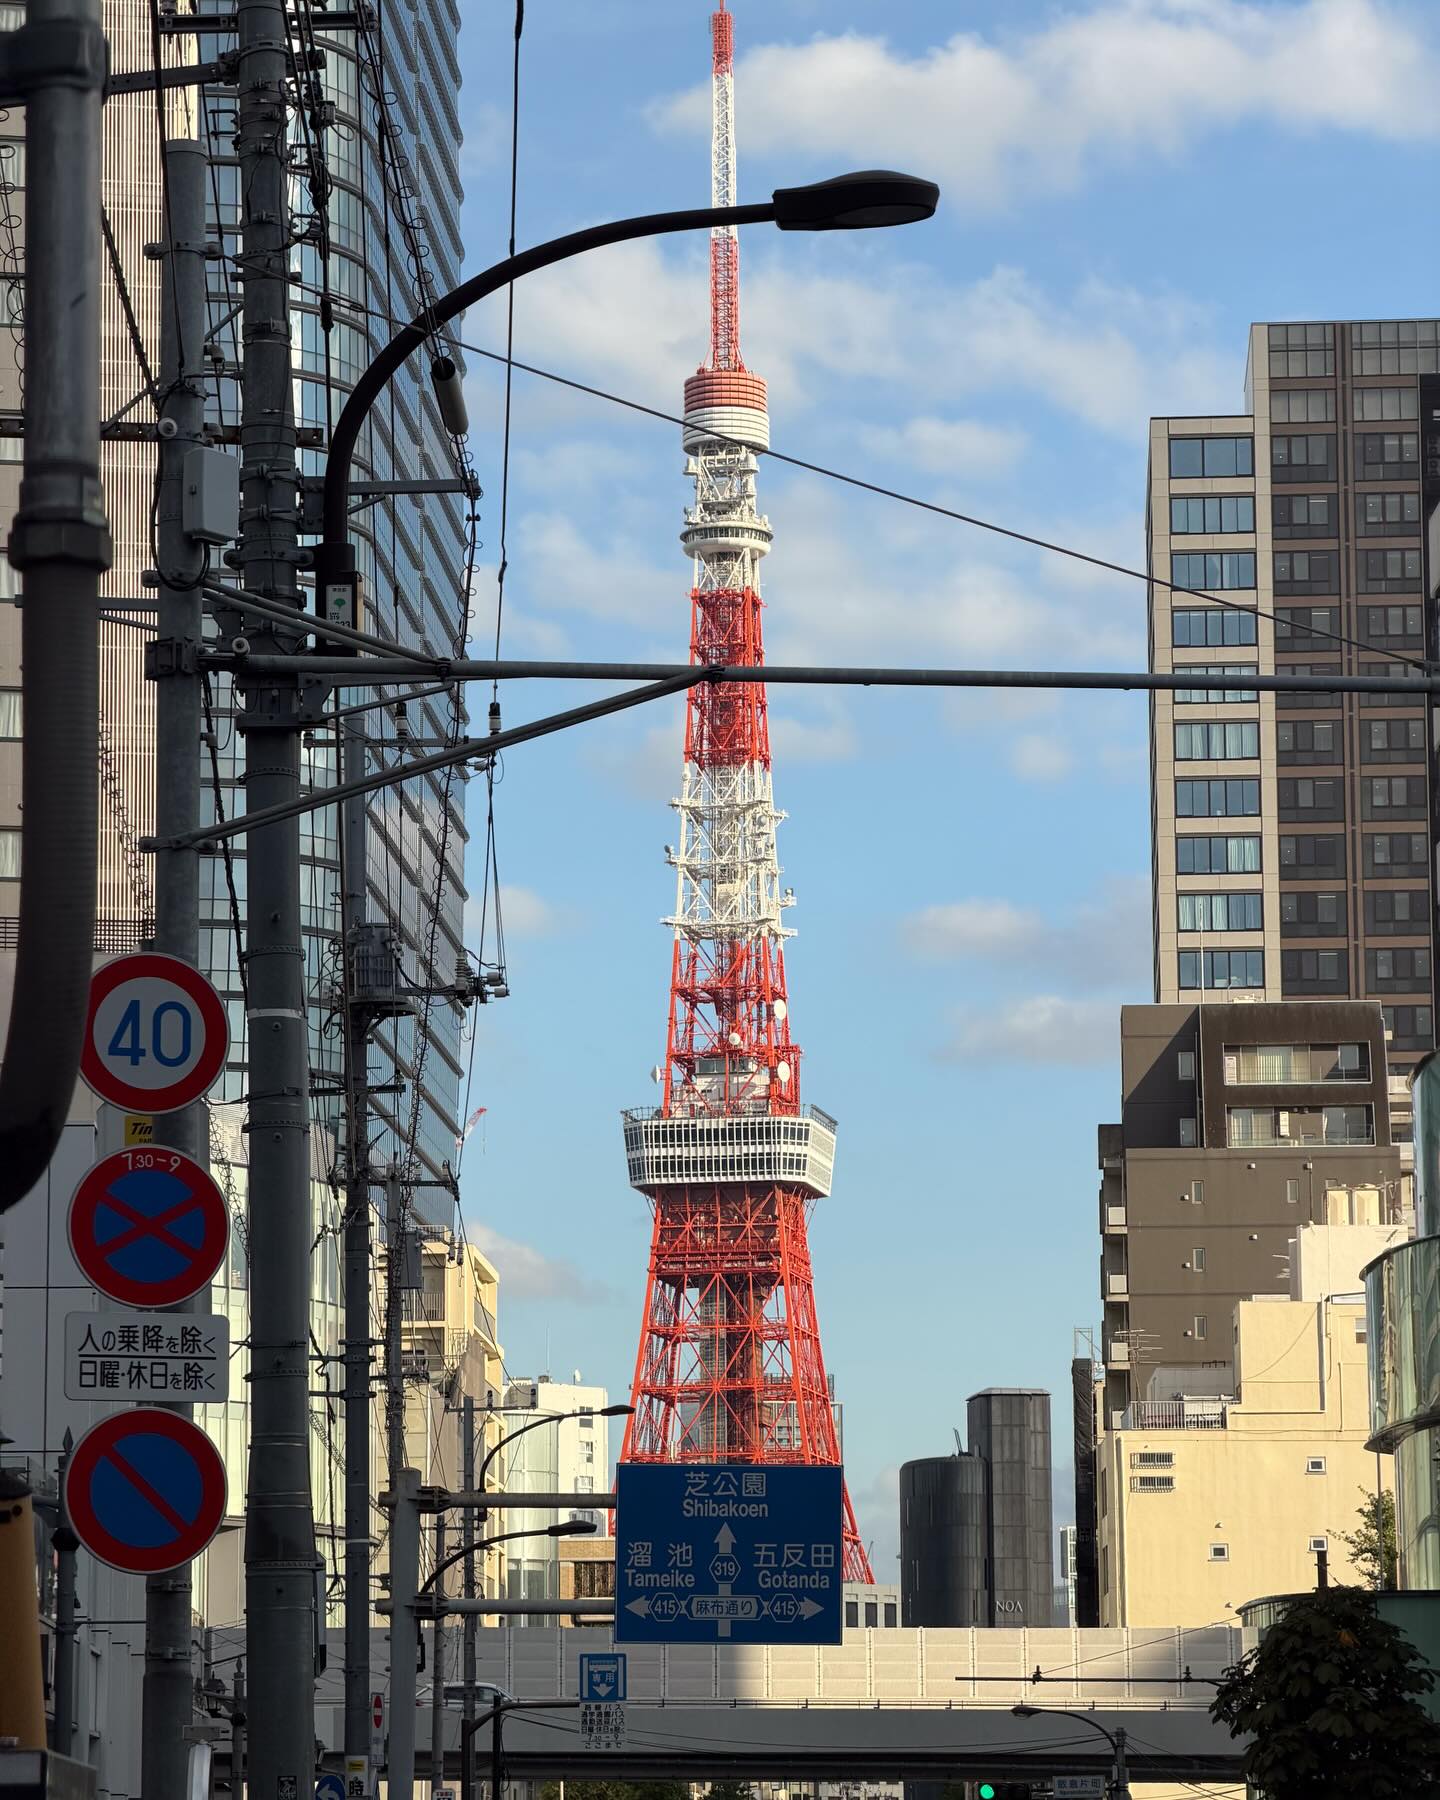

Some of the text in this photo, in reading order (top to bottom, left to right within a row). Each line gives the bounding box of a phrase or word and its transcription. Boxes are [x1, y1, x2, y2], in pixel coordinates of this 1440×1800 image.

[108, 999, 192, 1067] 40
[78, 1323, 216, 1354] 人の乗降を除く
[79, 1360, 216, 1390] 日曜・休日を除く
[684, 1472, 767, 1497] 芝公園
[682, 1499, 768, 1518] Shibakoen
[753, 1543, 835, 1568] 五反田
[714, 1561, 736, 1576] 319
[624, 1569, 695, 1588] Tameike
[758, 1570, 830, 1589] Gotanda
[654, 1600, 675, 1614] 415
[696, 1600, 753, 1616] 麻布通り
[773, 1600, 795, 1615] 415
[996, 1600, 1024, 1613] NOA
